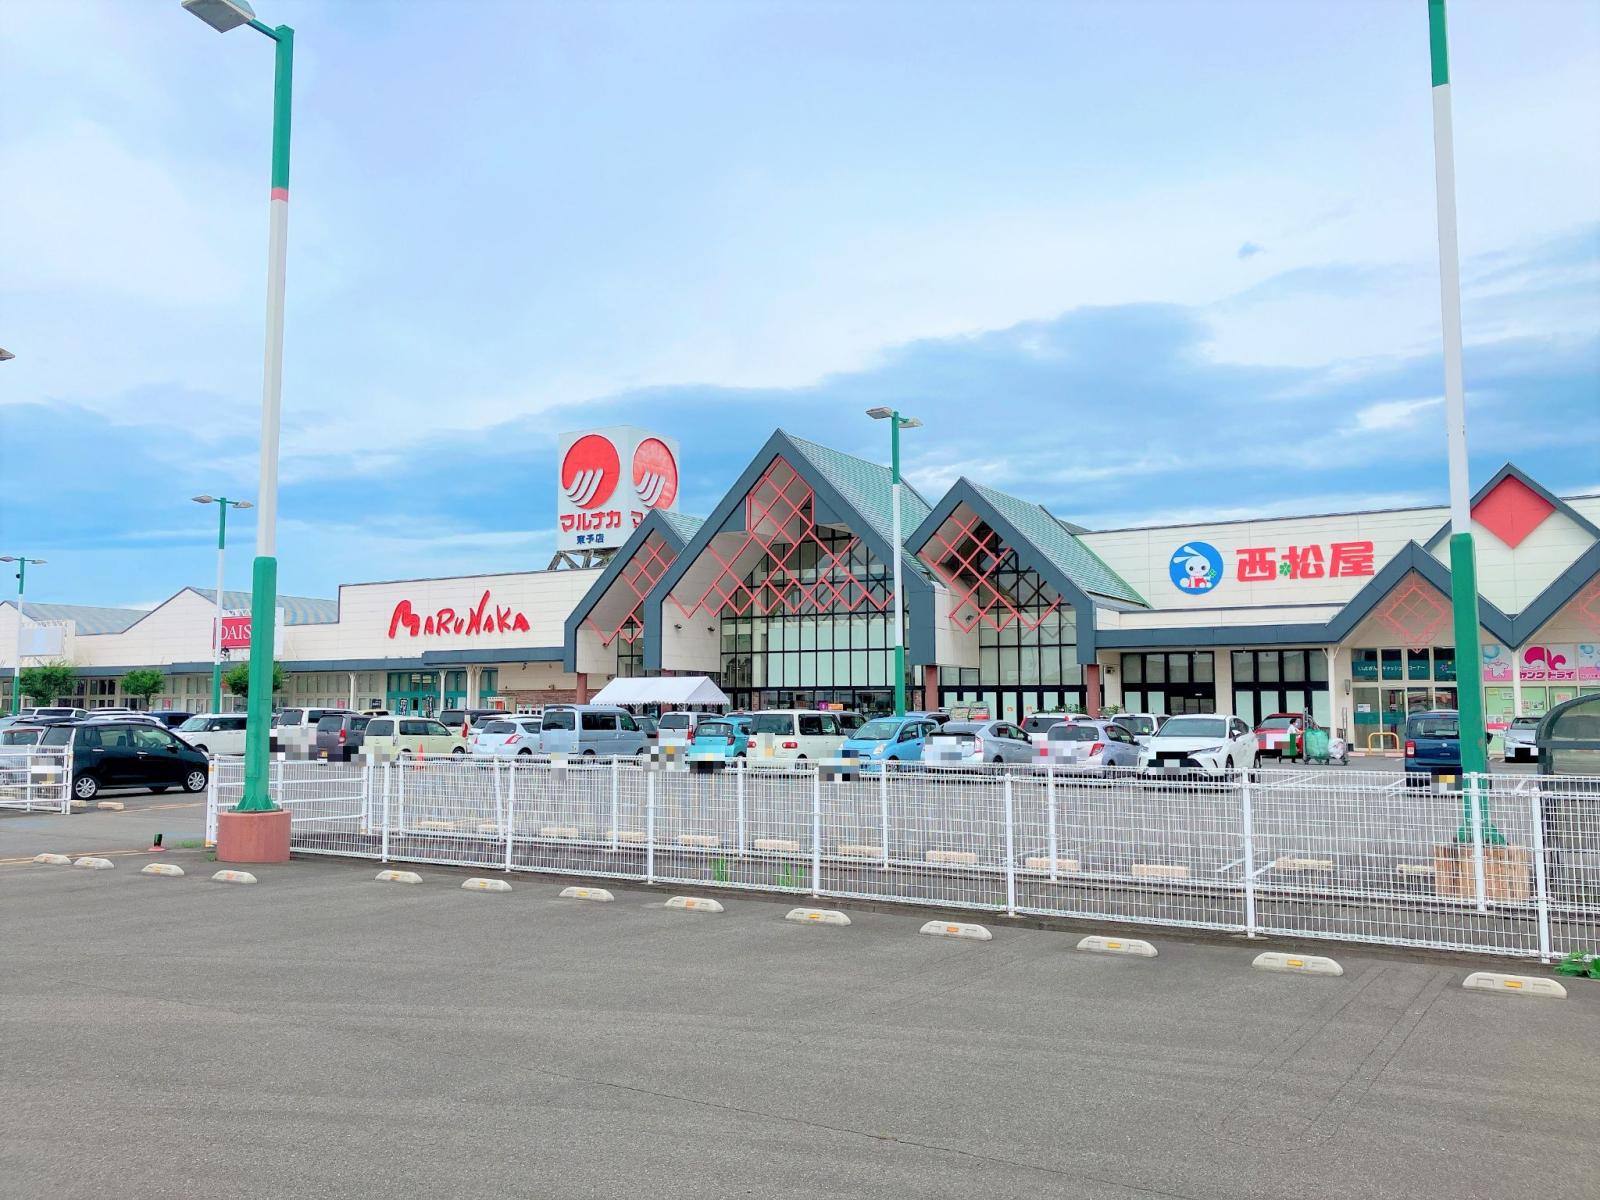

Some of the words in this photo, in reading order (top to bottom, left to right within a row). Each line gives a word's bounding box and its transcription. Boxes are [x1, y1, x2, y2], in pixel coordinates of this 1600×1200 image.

[560, 510, 622, 532] マルナカ
[576, 533, 605, 545] 東予店
[1236, 540, 1375, 583] 西松屋
[220, 624, 252, 640] DAIS
